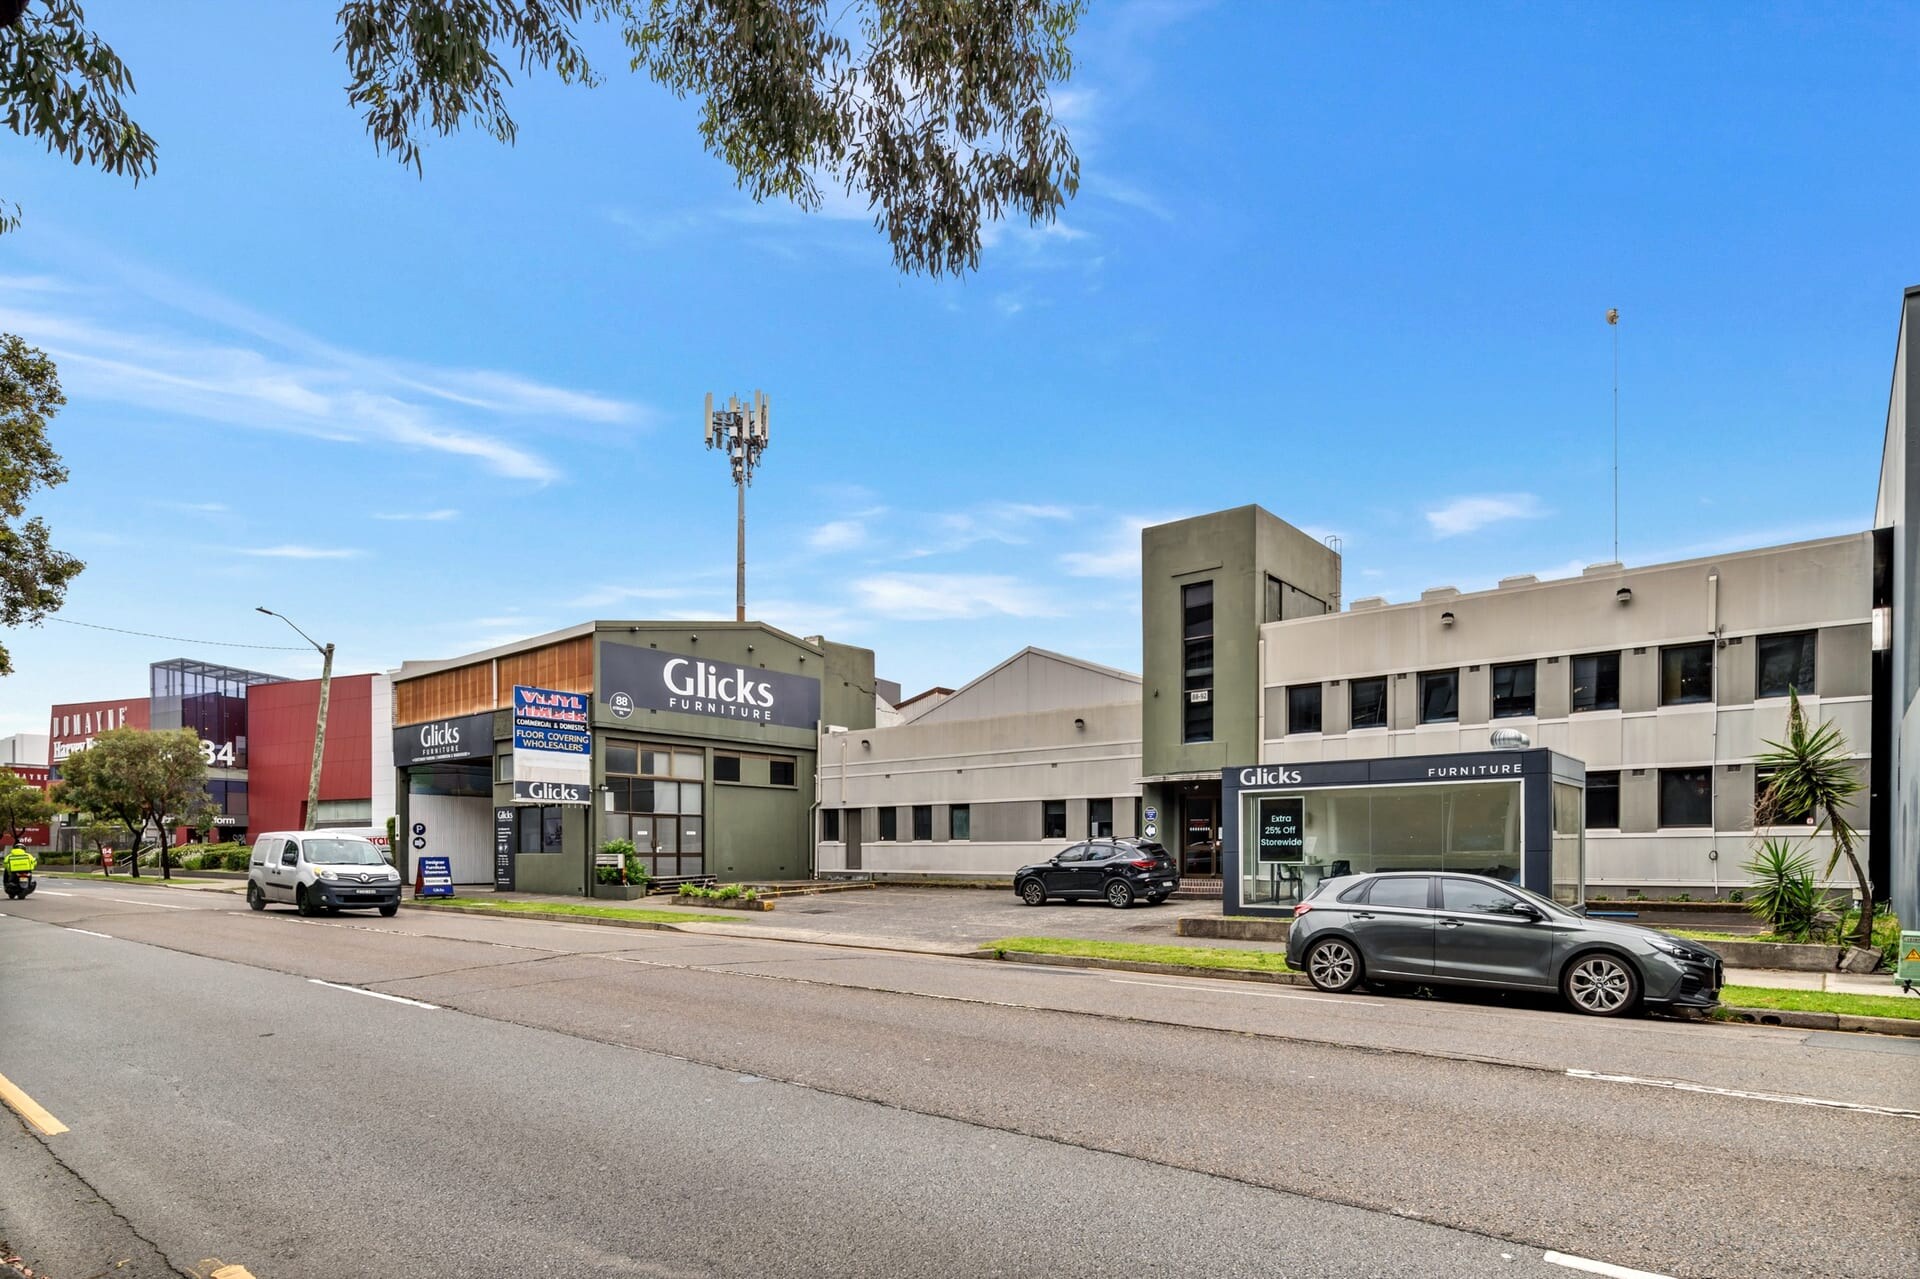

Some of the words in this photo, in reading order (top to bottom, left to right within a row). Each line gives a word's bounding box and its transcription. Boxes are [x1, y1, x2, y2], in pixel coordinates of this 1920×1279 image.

[663, 658, 774, 708] Glicks
[616, 696, 628, 706] 88
[669, 697, 772, 720] FURNITURE
[53, 706, 126, 738] DOMAYNE
[516, 718, 552, 729] COMMERCIAL
[559, 722, 585, 732] DOMESTIC
[420, 722, 460, 747] Glicks
[516, 729, 545, 739] FLOOR
[547, 732, 589, 744] COVERING
[422, 745, 459, 756] FURNITURE
[522, 738, 584, 752] WHOLESALERS
[1240, 766, 1302, 785] Glicks
[1428, 763, 1522, 777] FURNITURE
[528, 782, 579, 800] Glicks
[1271, 815, 1292, 823] Extra
[1264, 826, 1281, 835] 25%
[1282, 826, 1296, 834] Off
[1260, 838, 1302, 846] Storewide
